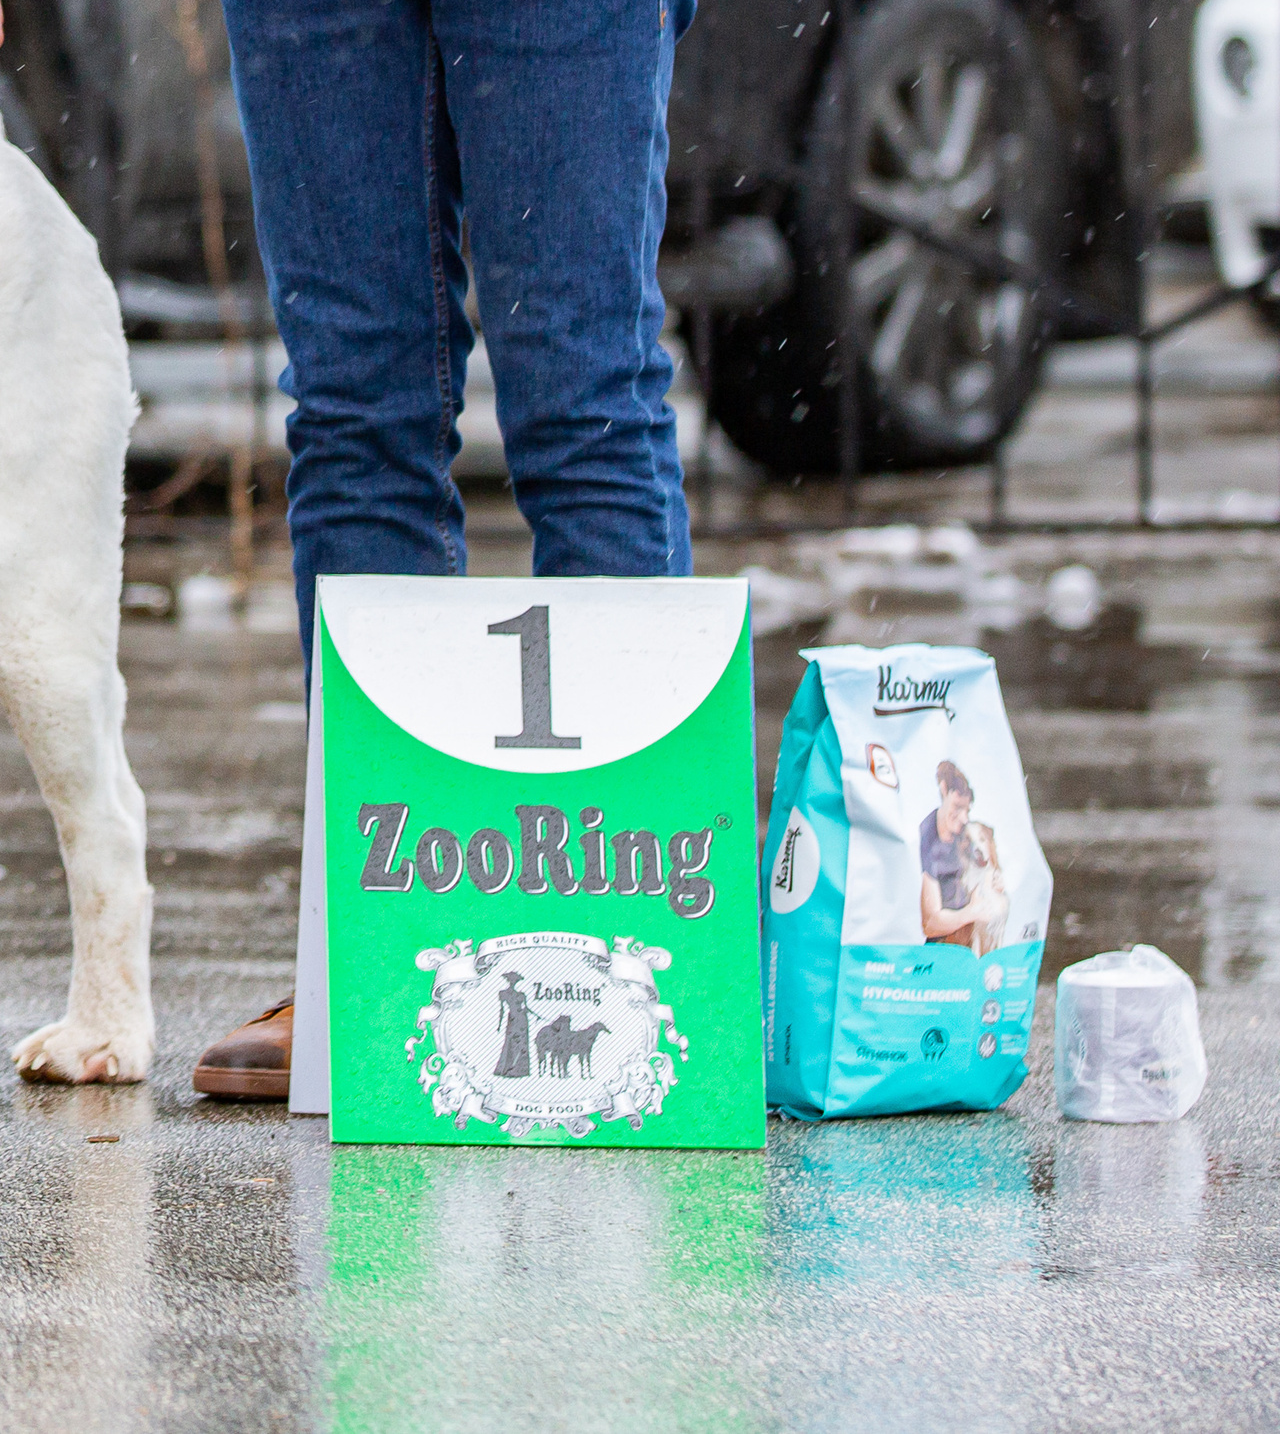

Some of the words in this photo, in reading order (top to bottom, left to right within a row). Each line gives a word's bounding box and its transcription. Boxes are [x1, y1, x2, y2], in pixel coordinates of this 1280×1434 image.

[487, 604, 582, 750] 1
[873, 664, 956, 724] Karmy
[496, 936, 527, 948] HIGH
[532, 935, 589, 947] QUALITY
[533, 982, 602, 1007] ZooRing
[862, 985, 972, 1003] HYPOALLERGENIC
[515, 1104, 543, 1114] DOG
[548, 1104, 584, 1114] FOOD
